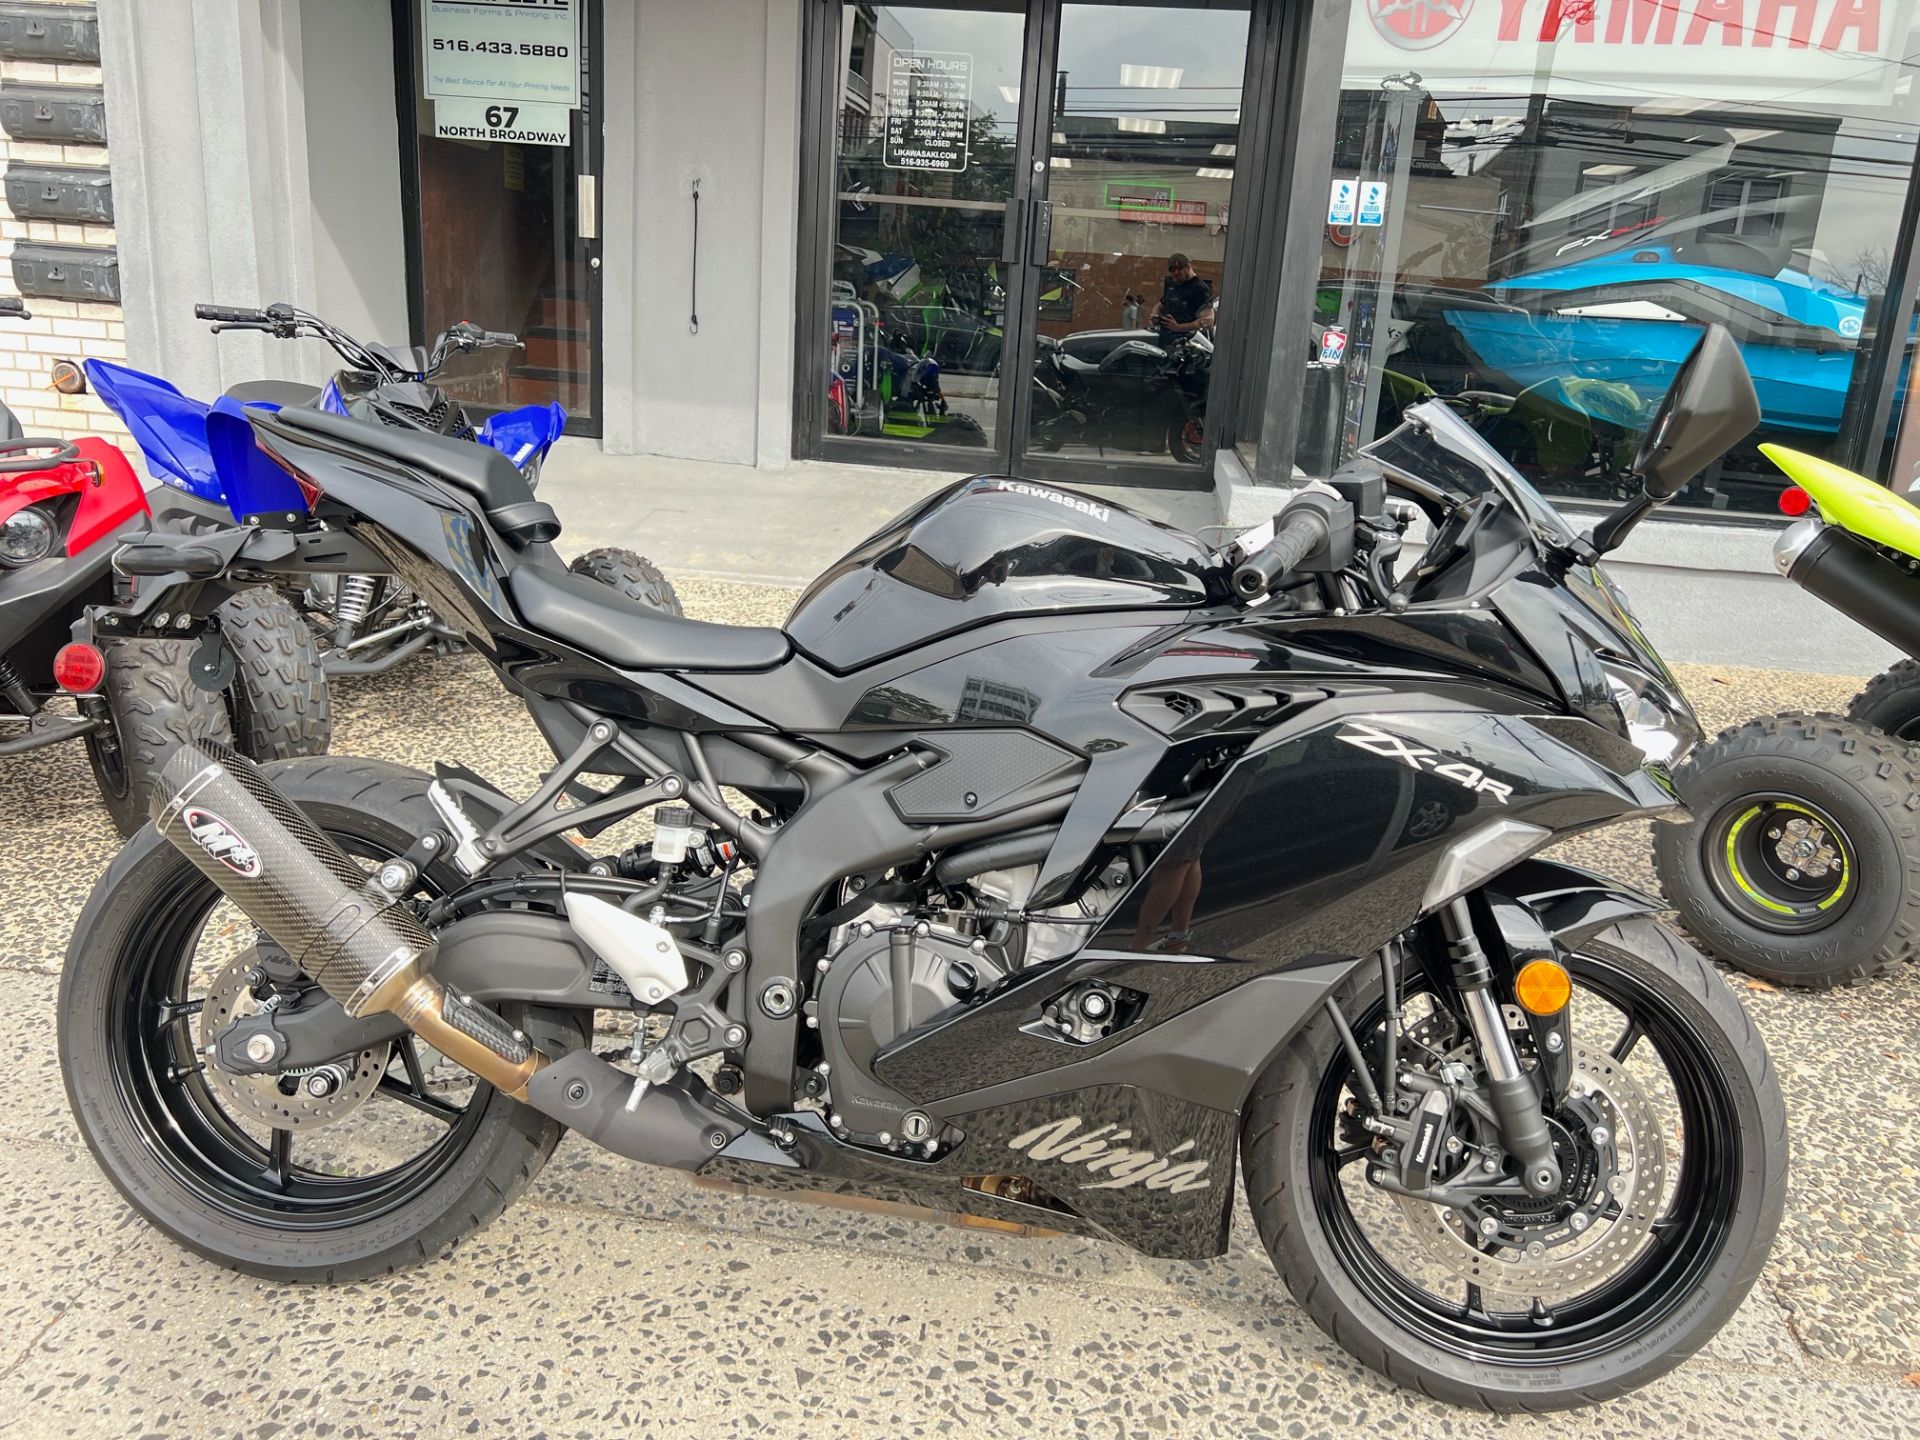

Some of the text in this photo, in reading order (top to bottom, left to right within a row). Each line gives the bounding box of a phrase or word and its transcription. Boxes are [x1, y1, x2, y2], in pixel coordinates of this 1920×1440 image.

[432, 6, 471, 15] Business
[473, 7, 501, 16] Forms
[554, 12, 570, 20] Inc.
[432, 38, 569, 58] 516.433.5880
[893, 57, 968, 71] OPEN HOURS
[433, 75, 444, 83] The
[445, 76, 460, 84] Best
[462, 78, 485, 86] Source
[524, 82, 549, 91] Printing
[550, 83, 571, 91] Needs
[485, 105, 519, 129] 67
[891, 108, 912, 116] THURS
[890, 117, 902, 125] FRI
[439, 126, 567, 143] NORTH BROADWAY
[890, 127, 903, 135] SAT
[924, 139, 951, 148] CLOSED
[893, 149, 957, 160] LIKAWASAKI.COM
[997, 480, 1110, 522] Kawasaki
[1335, 723, 1513, 805] ZX-4R
[1415, 1123, 1434, 1164] Kawasaki
[1008, 1115, 1211, 1194] Ninja
